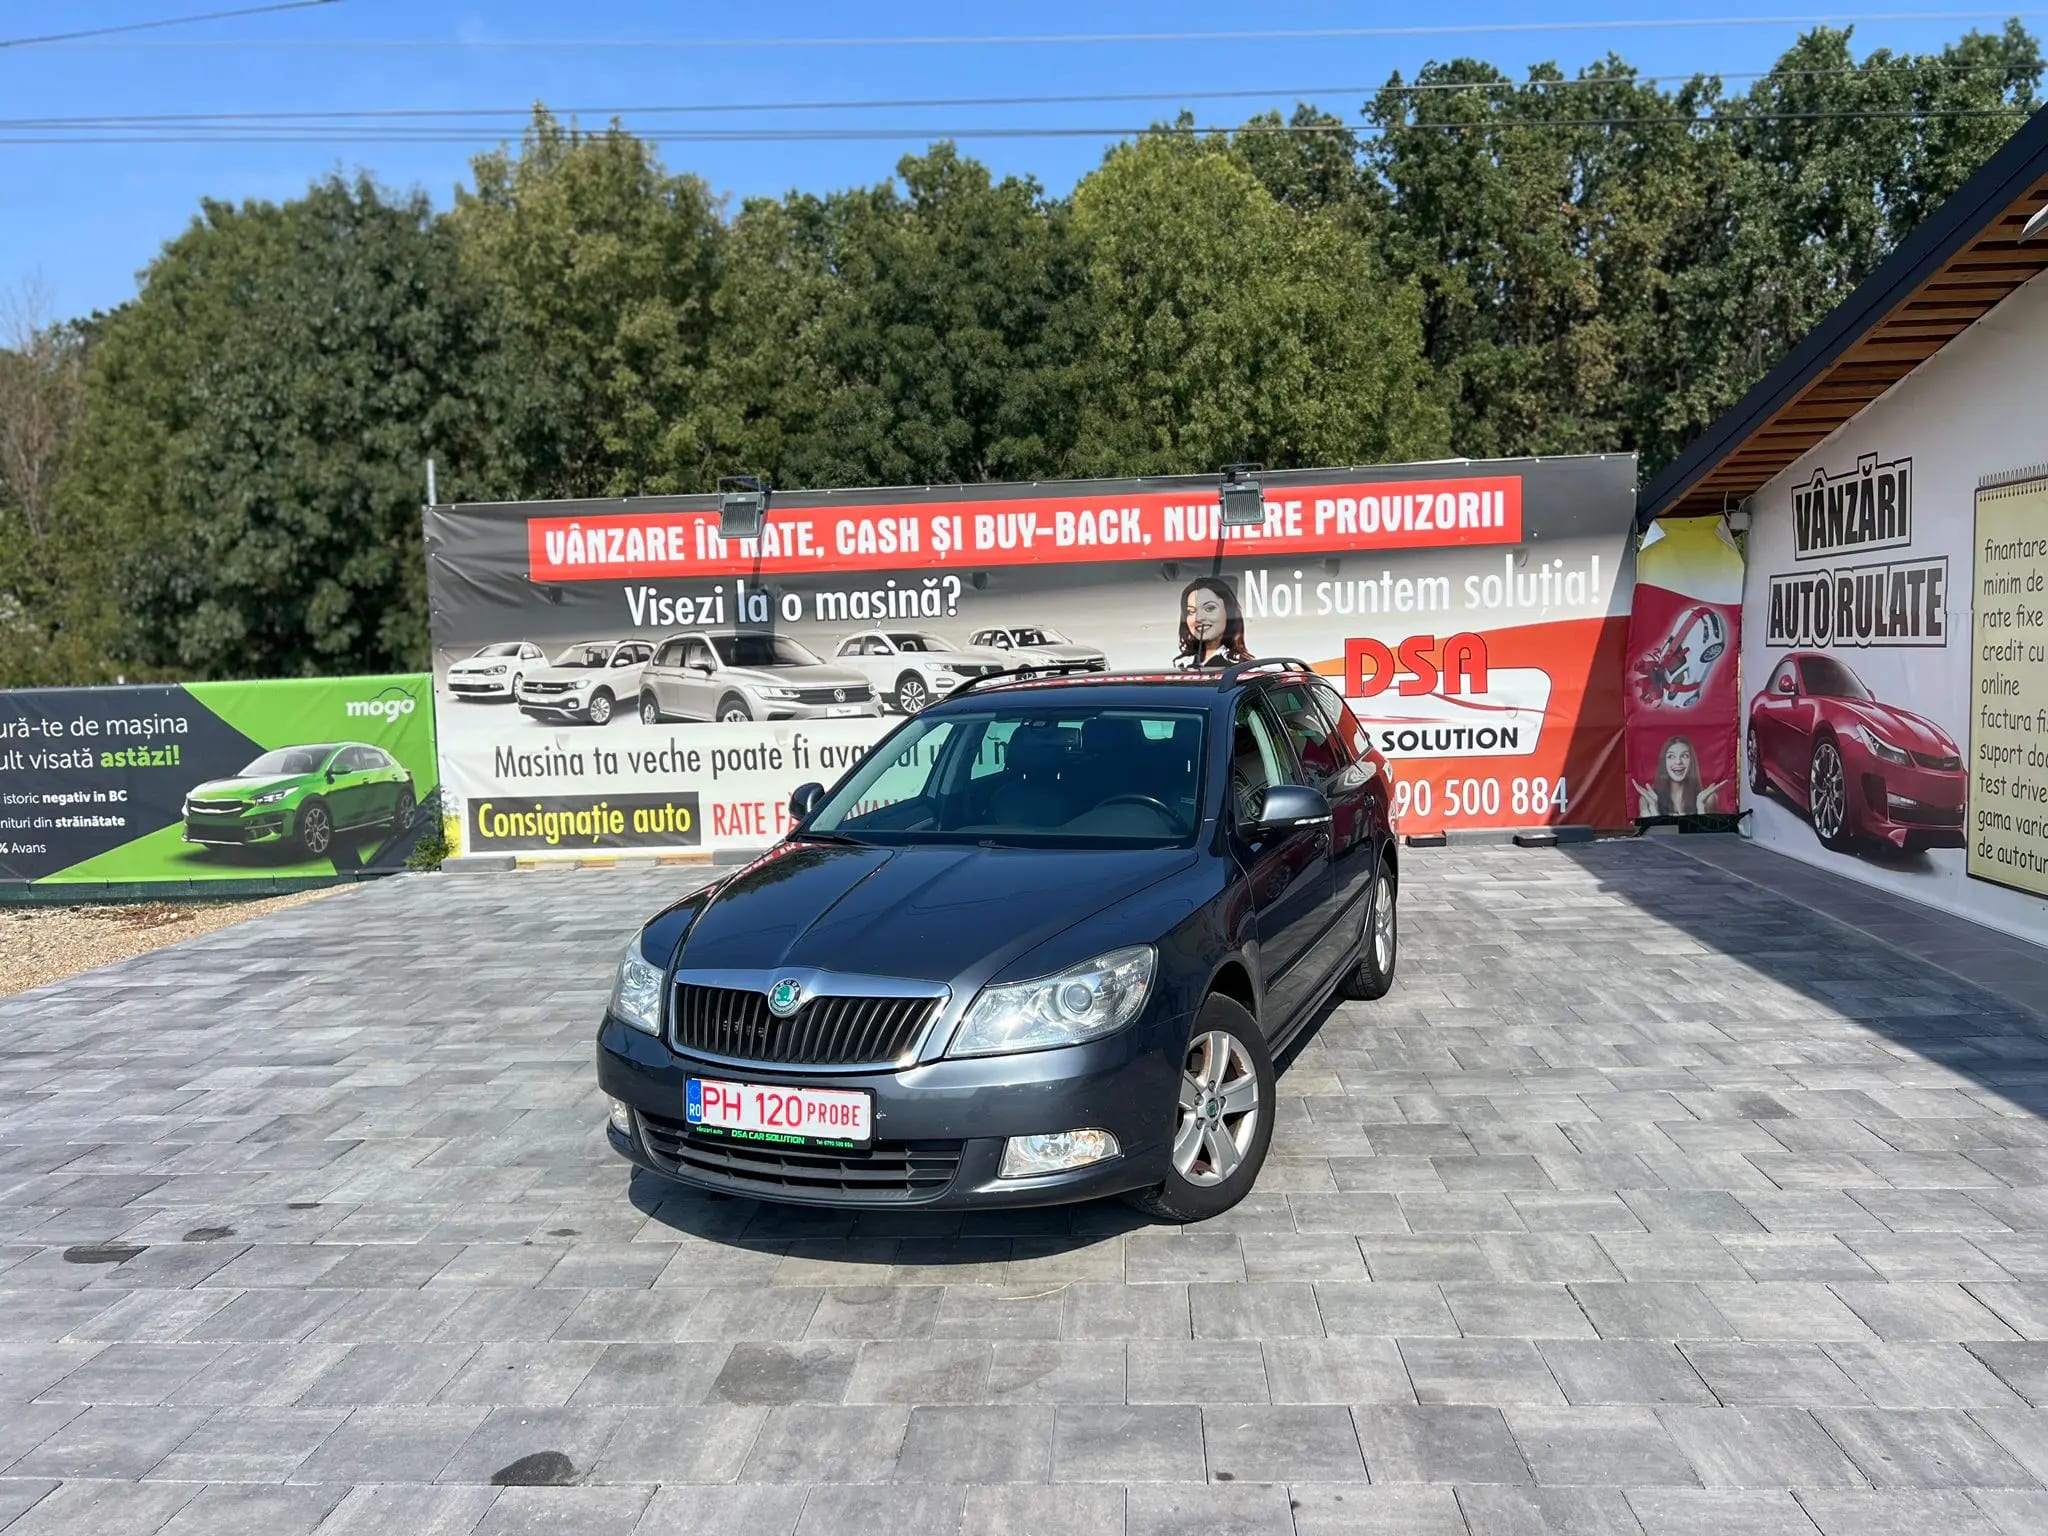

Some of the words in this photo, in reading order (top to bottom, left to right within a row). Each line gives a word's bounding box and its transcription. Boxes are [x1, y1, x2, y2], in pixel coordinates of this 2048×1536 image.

[1795, 464, 1907, 551] VÂNZĂRI
[545, 522, 685, 565] VÂNZARE
[693, 518, 728, 560] ÎN
[835, 517, 920, 555] CASH
[931, 515, 963, 560] ȘI
[975, 507, 1152, 550] BUY-BACK,
[1315, 490, 1505, 535] PROVIZORII
[1984, 537, 2047, 563] finantare
[1244, 570, 1303, 618] Noi
[1316, 570, 1450, 616] suntem
[1464, 553, 1600, 616] soluția!
[1983, 572, 2022, 595] minim
[2026, 568, 2044, 592] de
[623, 585, 725, 627] Visezi
[736, 578, 768, 623] la
[781, 592, 803, 621] o
[815, 575, 961, 628] mașină?
[1770, 579, 1830, 639] AUTO
[1837, 568, 1942, 638] RULATE
[1982, 608, 2012, 628] rate
[2016, 604, 2044, 628] fixe
[1982, 638, 2024, 662] credit
[2028, 645, 2045, 662] cu
[1344, 632, 1488, 698] DSA
[1981, 672, 2020, 696] online
[345, 699, 415, 723] mogo
[1980, 704, 2032, 732] factura
[2036, 708, 2048, 734] fi
[70, 716, 99, 736] de
[106, 714, 188, 739] mașina
[1382, 726, 1518, 752] SOLUTION
[29, 748, 93, 769] visată
[100, 745, 181, 768] astăzi!
[593, 746, 619, 775] ta
[628, 737, 701, 774] veche
[712, 742, 783, 780] poate
[792, 733, 810, 769] fi
[1979, 743, 2023, 768] suport
[3, 793, 40, 804] istoric
[42, 792, 91, 806] negativ
[108, 790, 128, 802] BC
[1444, 777, 1500, 816] 500
[1511, 776, 1568, 815] 884
[1979, 772, 2007, 796] test
[2011, 776, 2048, 803] drive
[33, 817, 52, 828] din
[55, 816, 126, 828] străinătate
[478, 802, 625, 844] Consignație
[633, 803, 691, 833] auto
[712, 802, 767, 836] RATE
[1977, 809, 2011, 832] gama
[11, 843, 47, 853] Avans
[1977, 836, 1994, 860] de
[690, 1103, 700, 1117] RO
[703, 1086, 741, 1121] PH
[756, 1092, 802, 1127] 120
[807, 1102, 861, 1127] PROBE
[731, 1129, 748, 1139] DSA
[748, 1131, 765, 1140] CAR
[766, 1133, 805, 1145] SOLUTION
